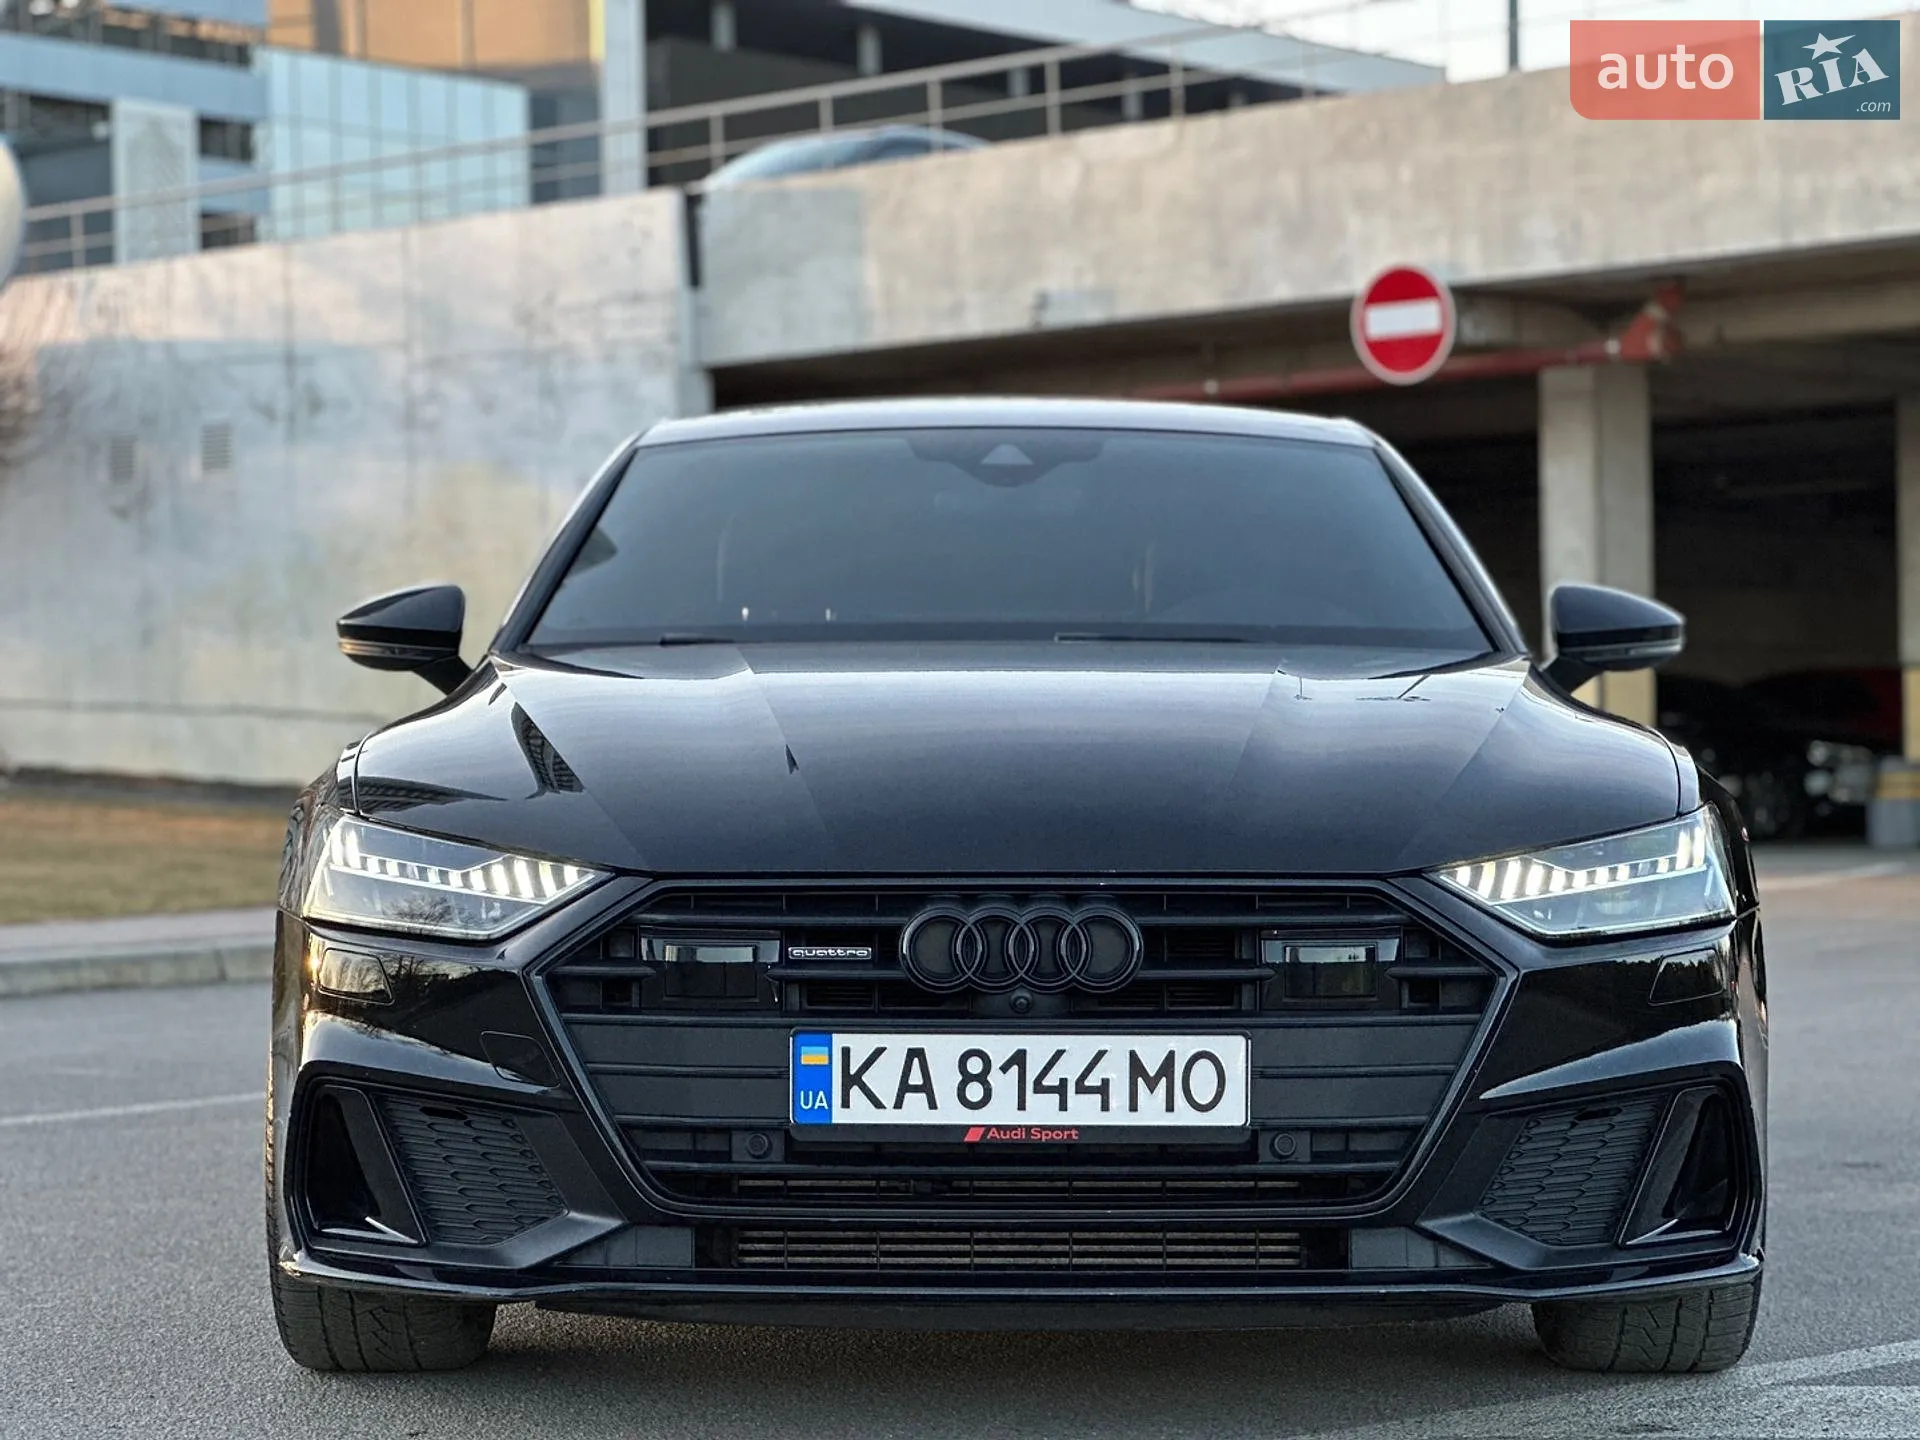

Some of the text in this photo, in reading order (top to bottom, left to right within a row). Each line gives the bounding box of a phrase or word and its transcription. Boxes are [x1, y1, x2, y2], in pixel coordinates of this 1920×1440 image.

[792, 948, 868, 958] quattro
[840, 1046, 1226, 1113] KA 8144 MO
[800, 1090, 828, 1110] UA
[986, 1127, 1079, 1142] Audi Sport
